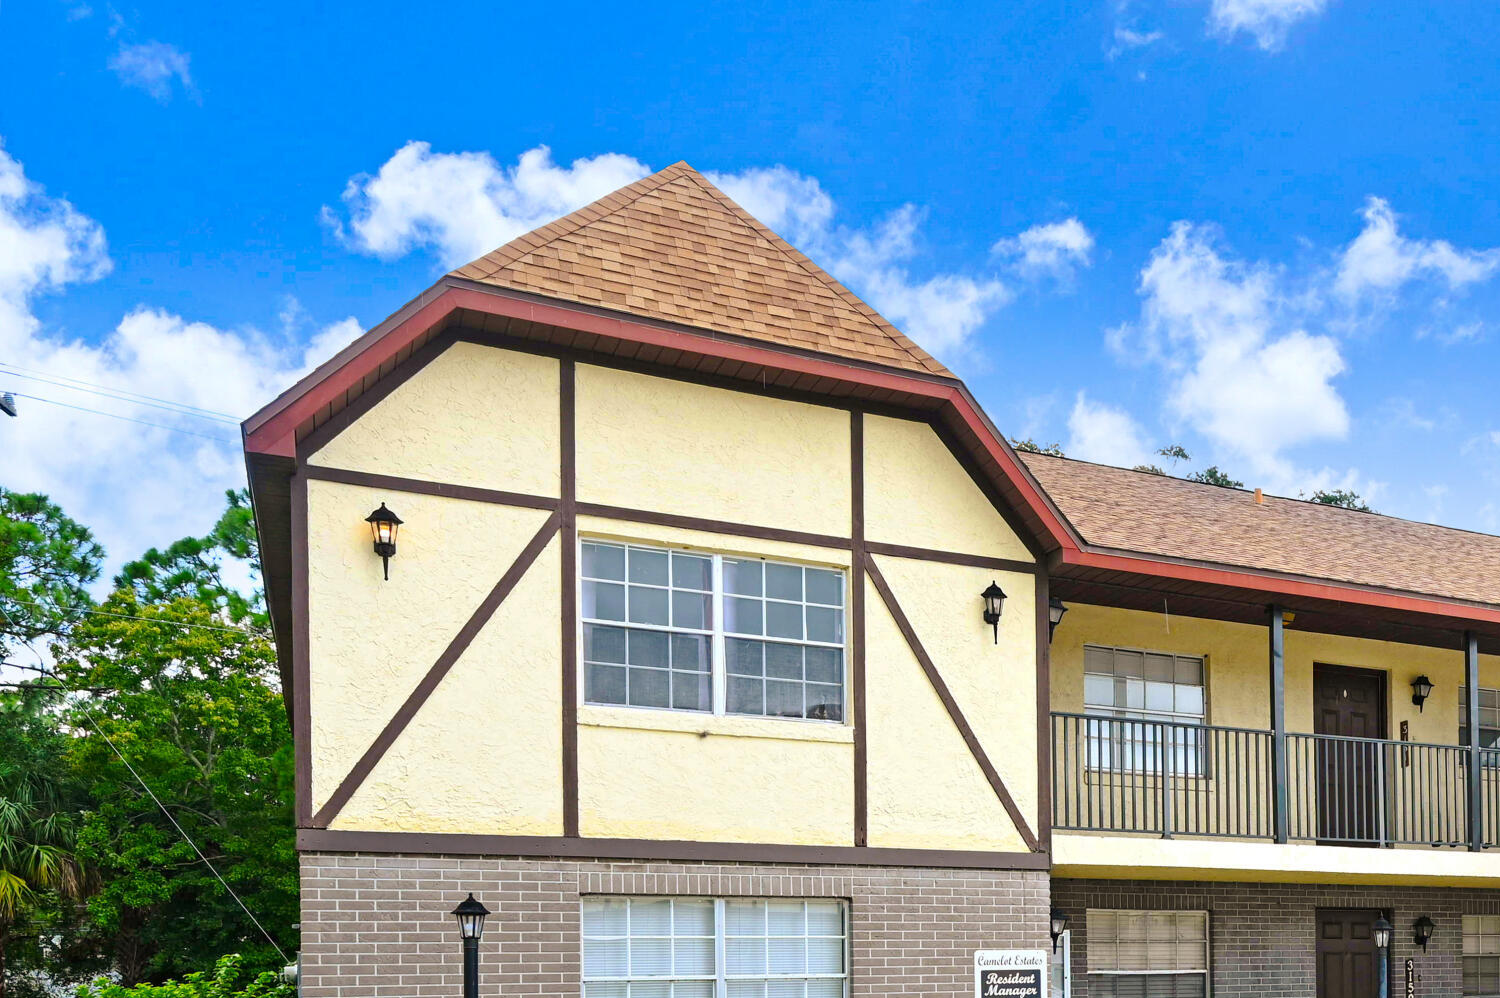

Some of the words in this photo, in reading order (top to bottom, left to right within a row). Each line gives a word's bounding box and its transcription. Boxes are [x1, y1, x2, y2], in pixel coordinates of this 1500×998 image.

[977, 955, 1012, 967] Camelot
[1014, 954, 1043, 966] Estates
[986, 972, 1036, 985] Resident
[984, 984, 1038, 998] Manager
